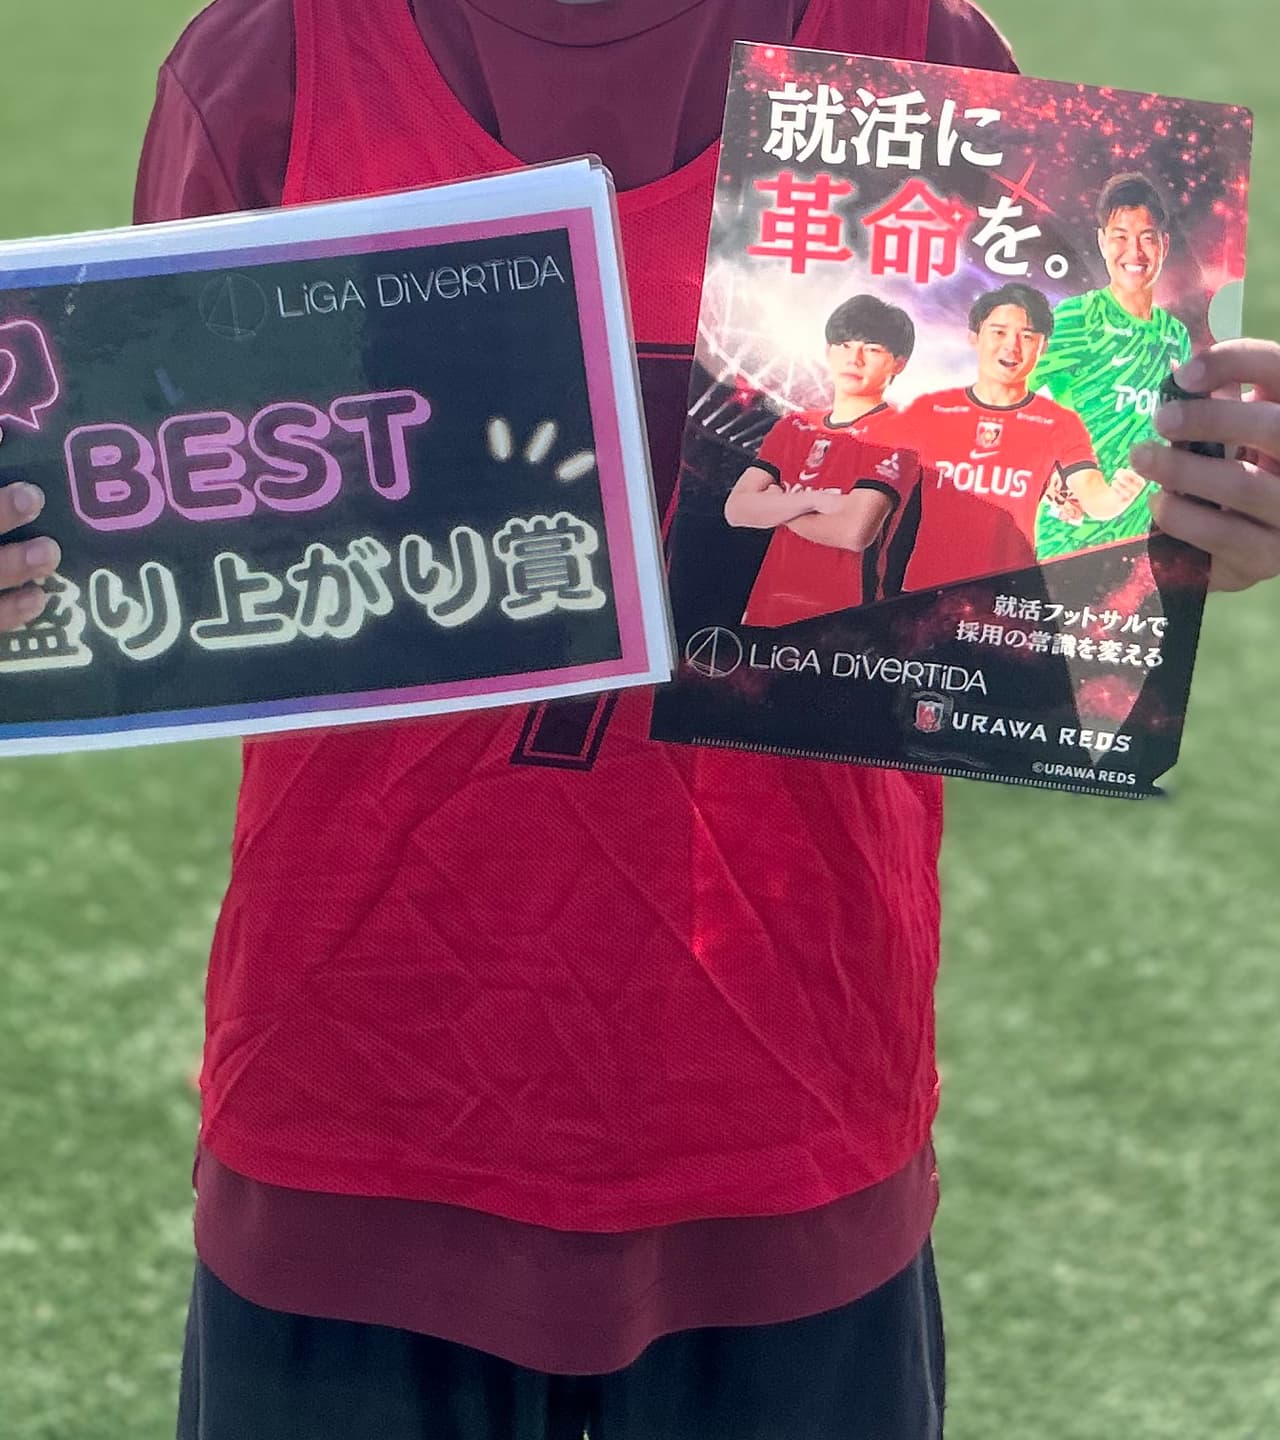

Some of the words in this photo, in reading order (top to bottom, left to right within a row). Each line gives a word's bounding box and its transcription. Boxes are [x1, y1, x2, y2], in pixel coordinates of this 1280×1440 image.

[762, 82, 1004, 170] 就活に
[746, 170, 1070, 284] 革命を。
[63, 388, 432, 532] BEST
[934, 460, 1033, 498] POLUS
[992, 593, 1169, 638] 就活フットサルで
[954, 619, 1164, 668] 採用の常識を変える
[951, 711, 1048, 743] URAWA
[1058, 727, 1133, 753] REDS
[1097, 765, 1137, 786] REDS
